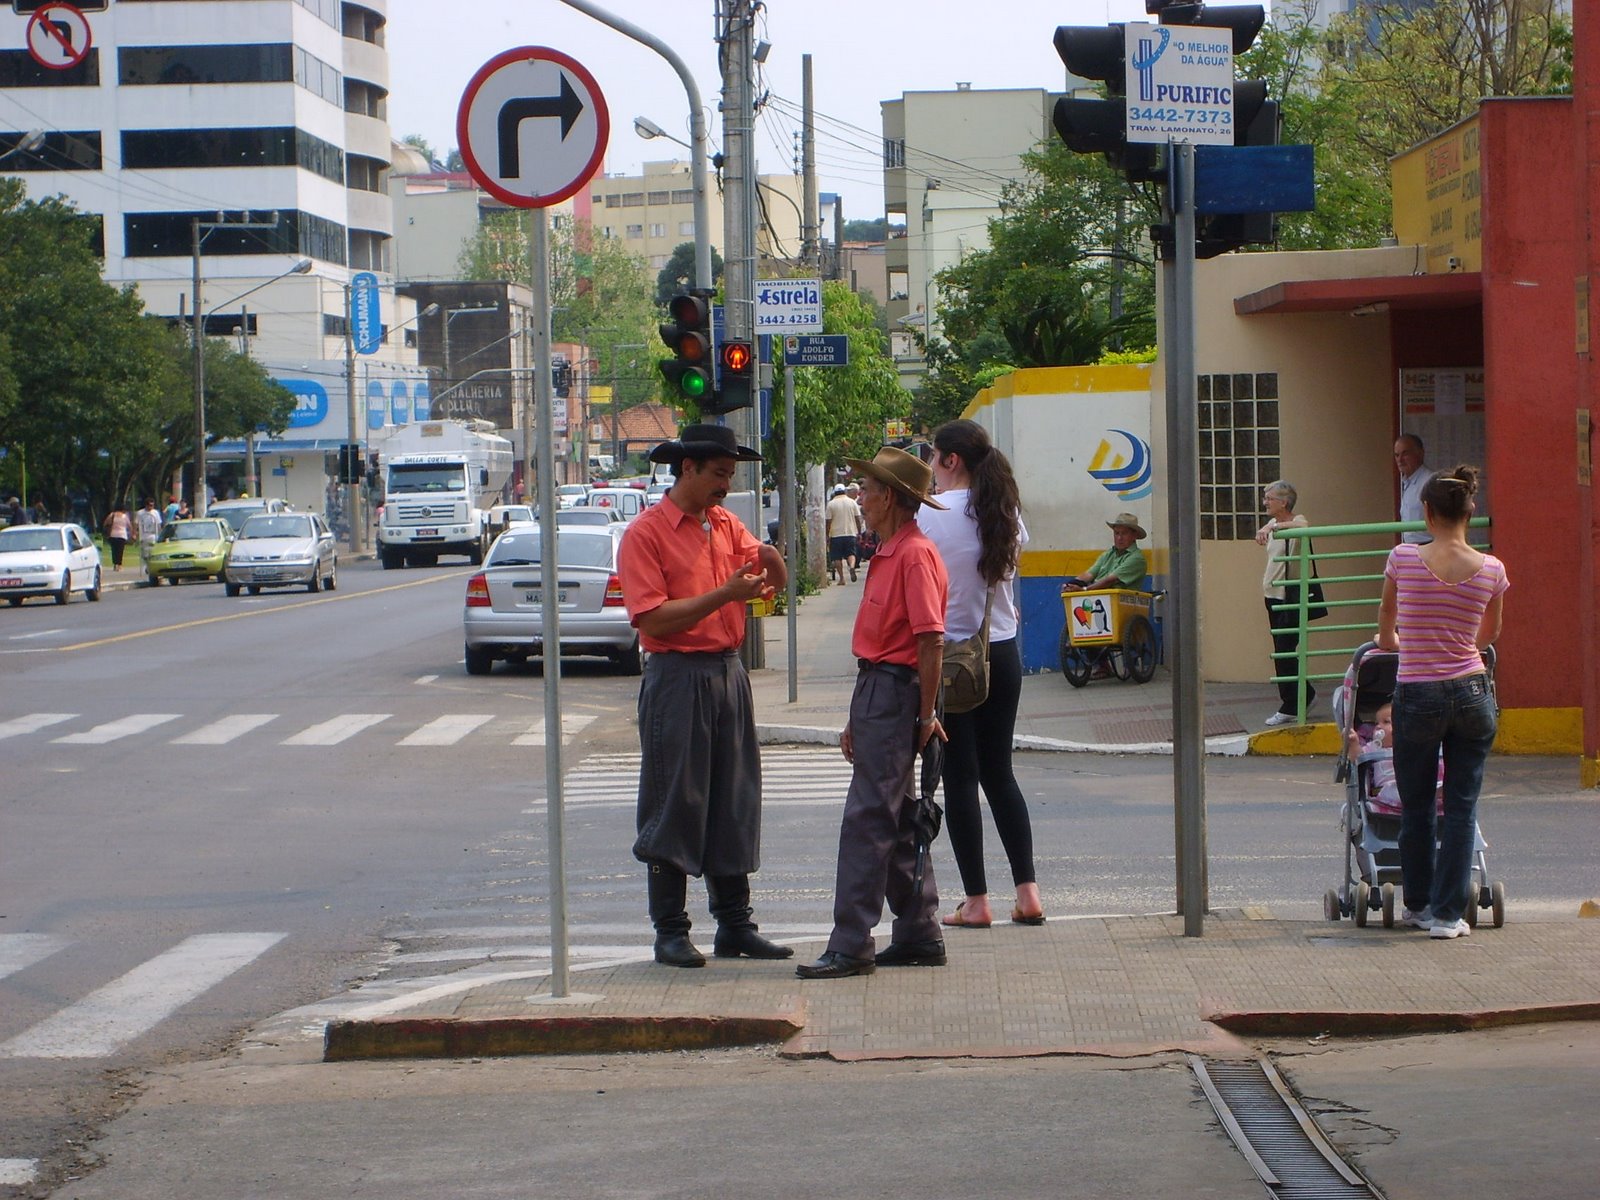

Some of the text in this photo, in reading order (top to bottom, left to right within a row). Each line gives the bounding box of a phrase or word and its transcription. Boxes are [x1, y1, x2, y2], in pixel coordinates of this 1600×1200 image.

[1187, 42, 1229, 54] MELHOR
[1181, 55, 1195, 65] DA
[1156, 84, 1232, 105] PURIFIC
[1129, 107, 1232, 124] 3442-7373
[757, 287, 819, 306] Estrela
[357, 276, 370, 350] SCHUMANN
[758, 314, 817, 325] 3442 4258
[808, 337, 825, 345] RUA
[802, 346, 834, 354] ADOLFO
[801, 354, 835, 362] KONDER
